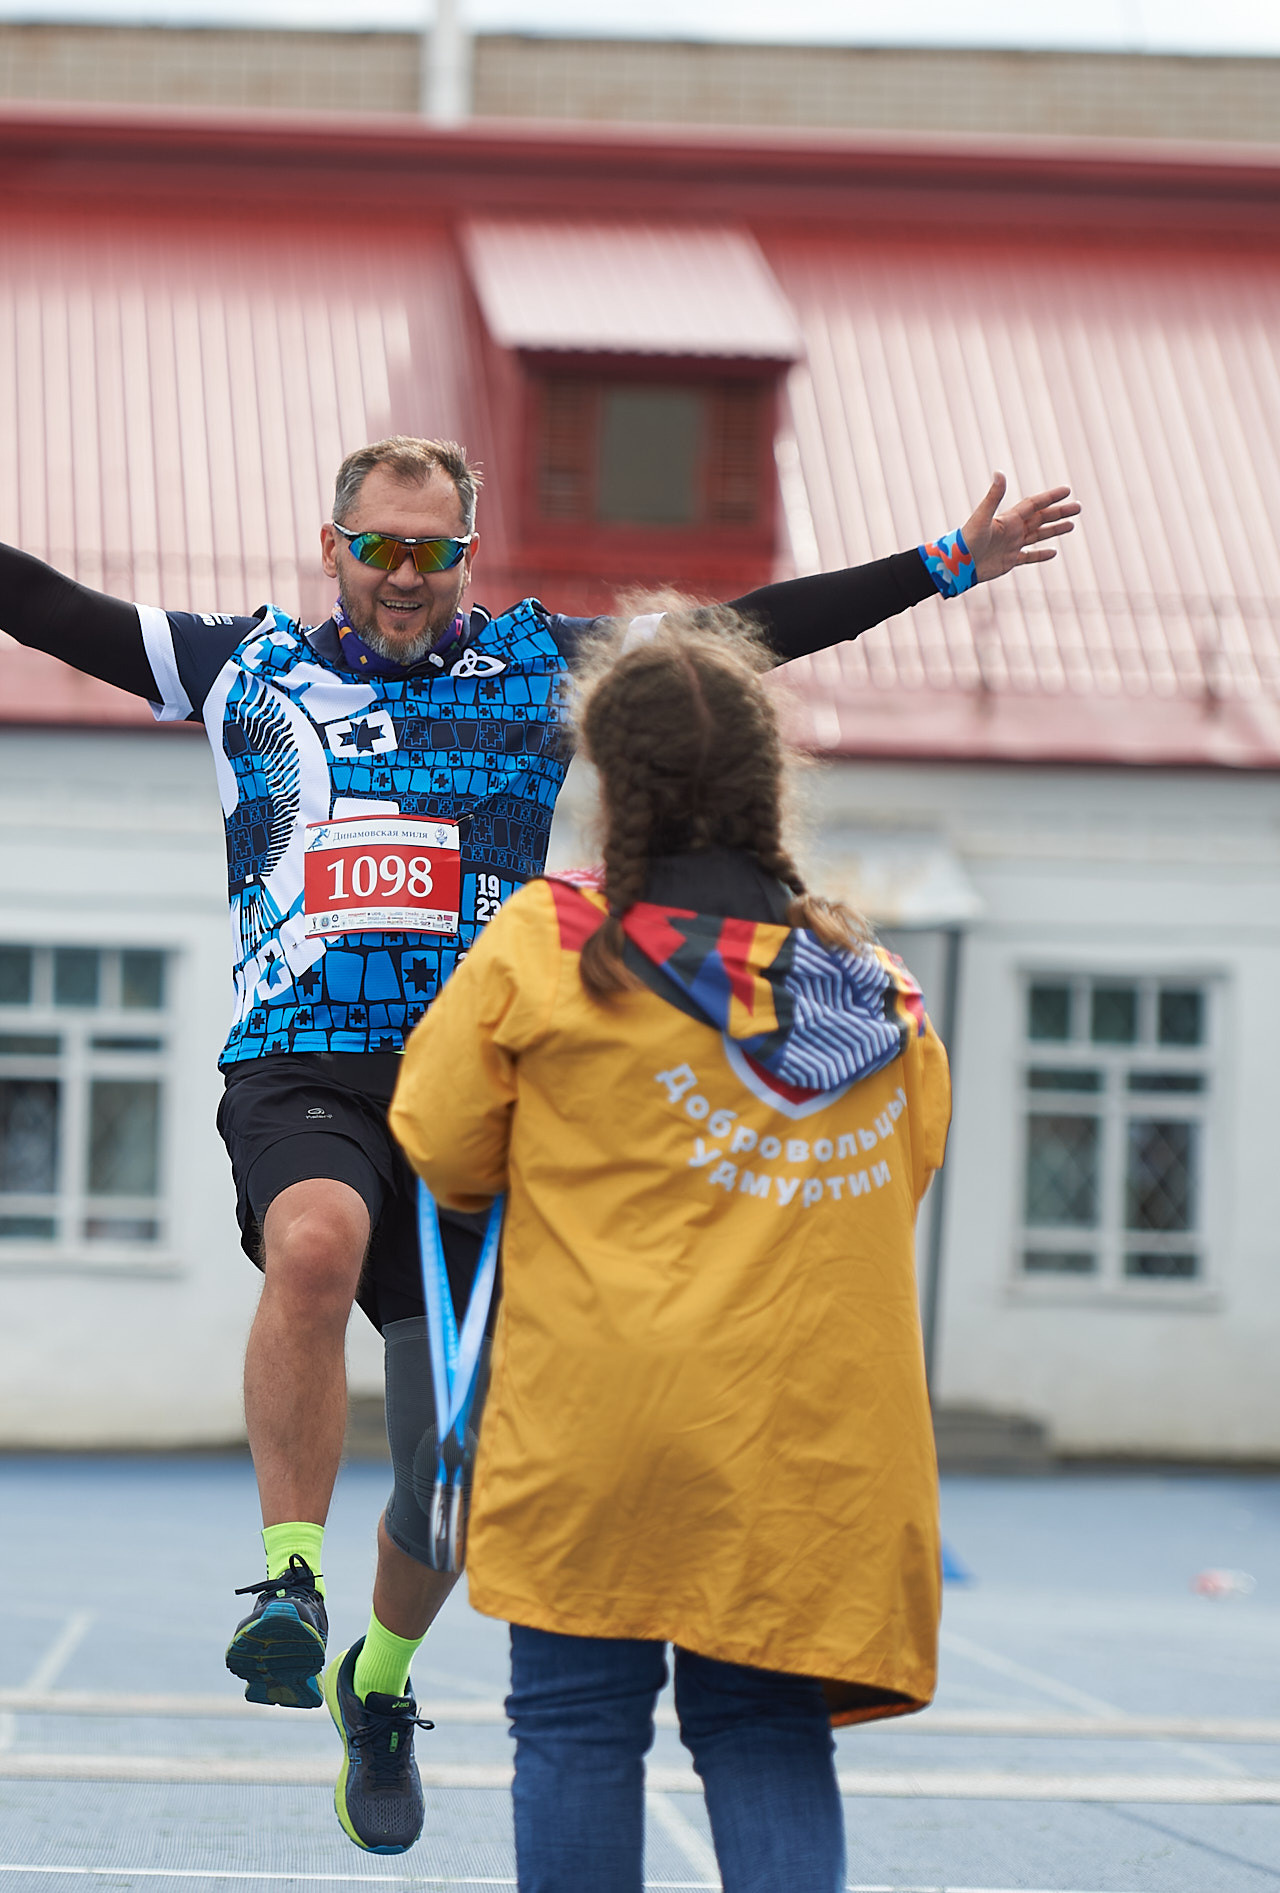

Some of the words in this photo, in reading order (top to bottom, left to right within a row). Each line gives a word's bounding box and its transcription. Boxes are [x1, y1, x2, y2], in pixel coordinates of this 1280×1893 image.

[332, 829, 399, 842] Динамовская
[401, 831, 428, 839] миля
[326, 855, 433, 900] 1098
[477, 873, 500, 899] 19
[654, 1063, 908, 1163] Добровольцы
[688, 1137, 892, 1208] Удмуртии
